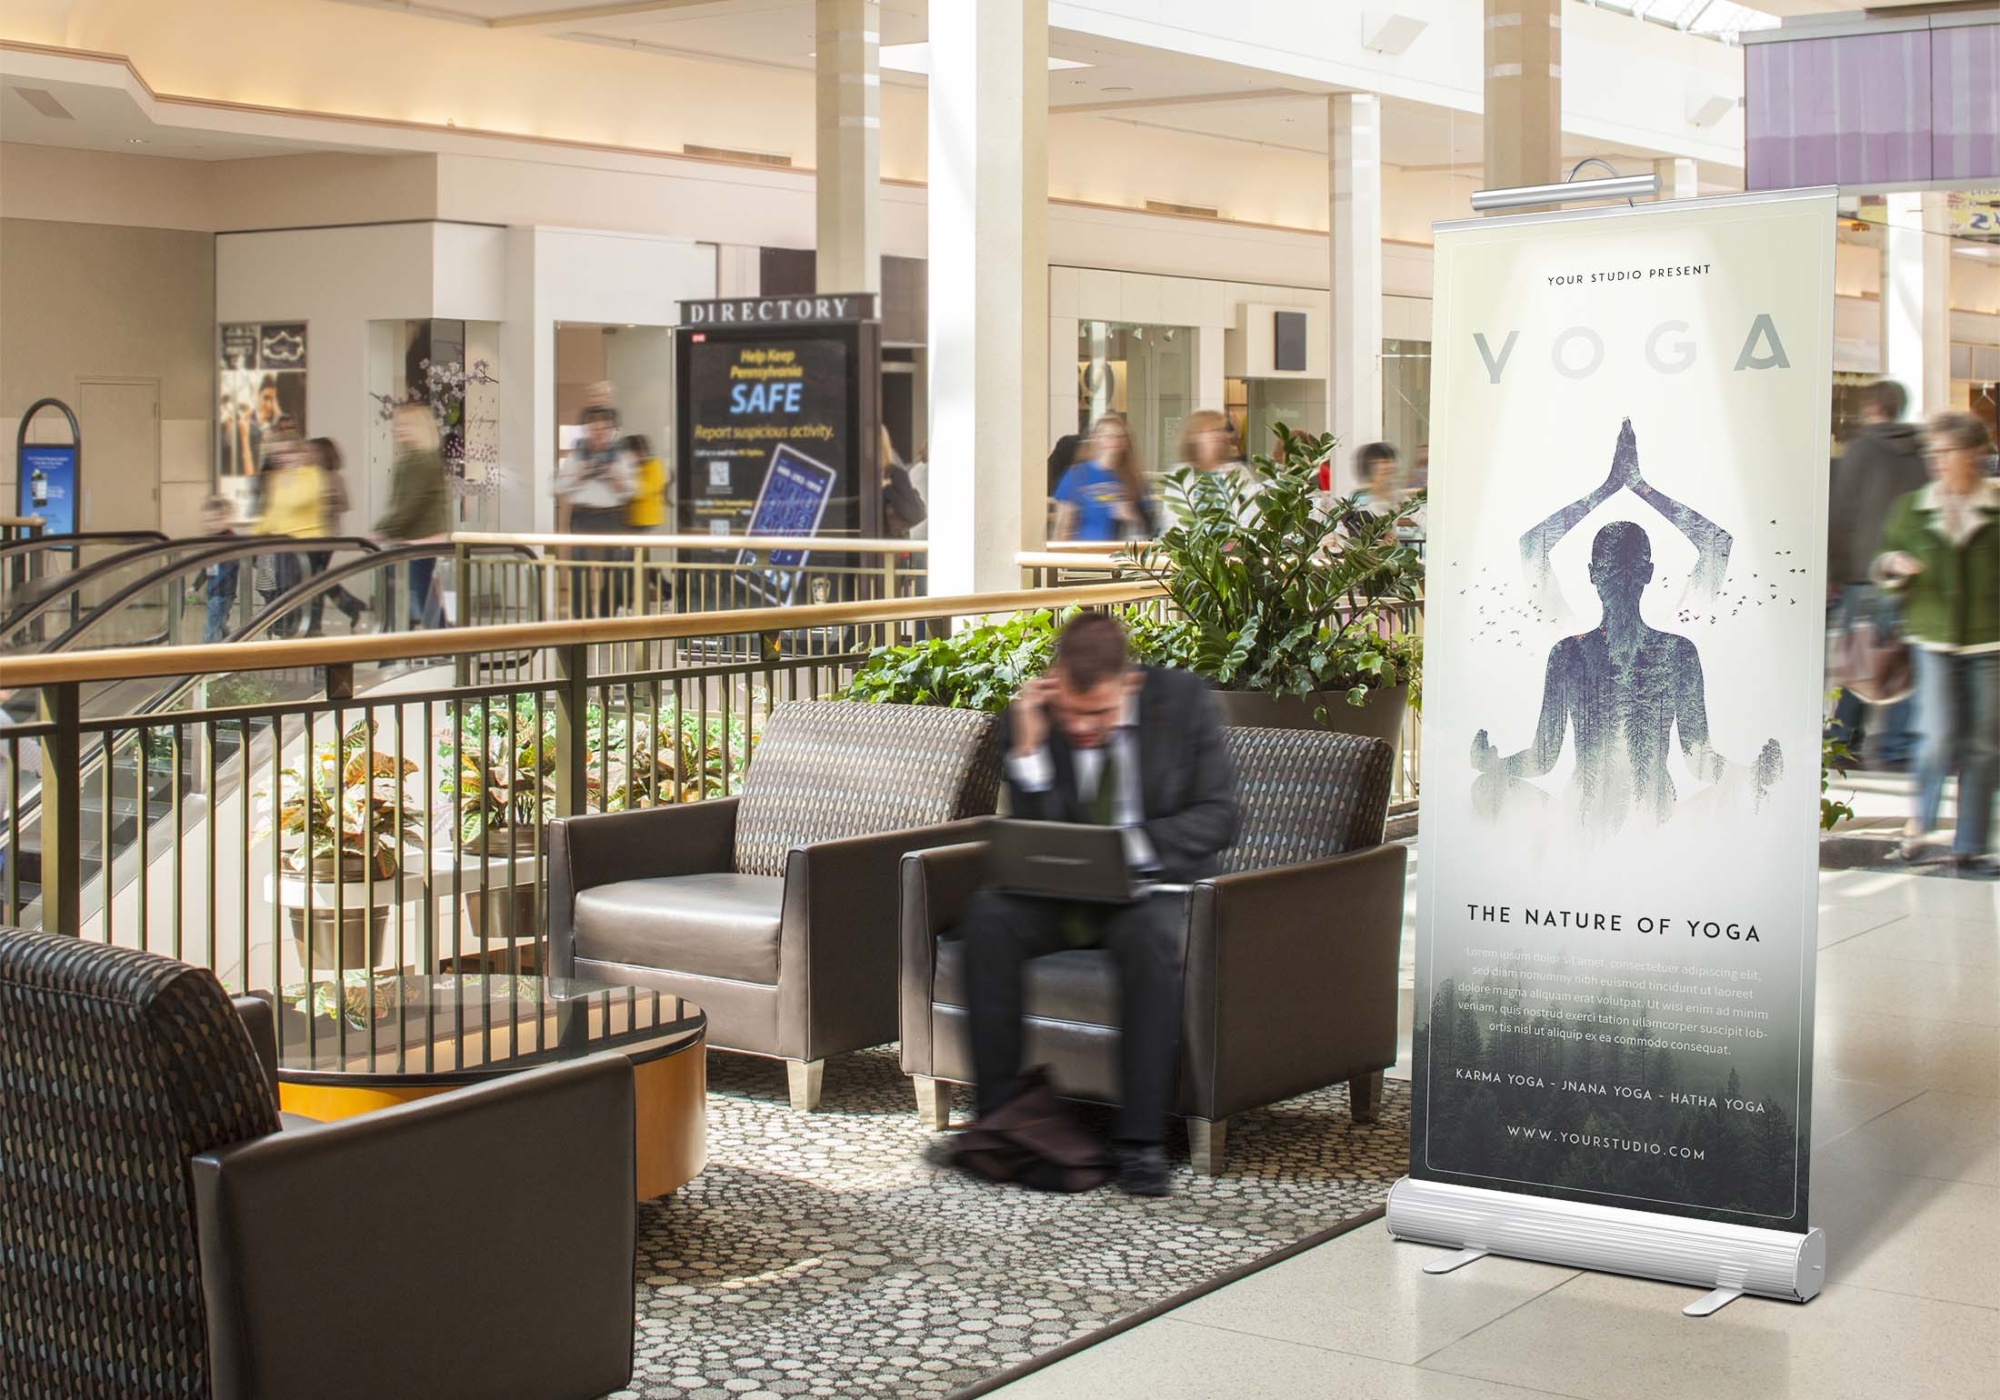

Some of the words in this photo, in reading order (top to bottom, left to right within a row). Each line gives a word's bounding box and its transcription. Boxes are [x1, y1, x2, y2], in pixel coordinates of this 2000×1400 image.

[1548, 274, 1583, 286] YOUR
[1591, 270, 1642, 283] STUDIO
[1649, 264, 1711, 278] PRESENT
[689, 298, 848, 323] DIRECTORY
[1472, 313, 1791, 384] YOGA
[729, 382, 803, 414] SAFE
[694, 424, 732, 441] Report
[1467, 904, 1511, 924] THE
[1525, 908, 1622, 932] NATURE
[1637, 917, 1671, 935] OF
[1687, 920, 1760, 942] YOGA
[1466, 947, 1498, 959] Lorem
[1500, 950, 1531, 963] ipsum
[1682, 964, 1738, 981] adipiscing
[1740, 968, 1762, 983] elit,
[1471, 965, 1490, 976] sed
[1492, 967, 1518, 978] diam
[1520, 971, 1572, 986] nonummy
[1575, 973, 1598, 986] nibh
[1600, 977, 1646, 990] euismod
[1648, 979, 1698, 995] tincidunt
[1700, 985, 1712, 996] ut
[1714, 986, 1753, 1000] laoreet
[1458, 982, 1491, 995] dolore
[1492, 986, 1527, 999] magna
[1529, 988, 1571, 1002] aliquam
[1573, 993, 1595, 1004] erat
[1597, 994, 1645, 1009] volutpat.
[1647, 999, 1660, 1010] Ut
[1662, 1001, 1684, 1012] wisi
[1685, 1003, 1713, 1015] enim
[1716, 1005, 1730, 1017] ad
[1732, 1007, 1769, 1020] minim
[1458, 1001, 1498, 1014] veniam,
[1500, 1006, 1521, 1018] quis
[1523, 1008, 1563, 1020] nostrud
[1565, 1011, 1596, 1023] exerci
[1598, 1014, 1630, 1027] tation
[1632, 1016, 1698, 1033] ullamcorper
[1700, 1024, 1743, 1038] suscipit
[1745, 1027, 1768, 1039] lob-
[1489, 1022, 1512, 1033] ortis
[1514, 1022, 1532, 1036] nisl
[1534, 1025, 1545, 1037] ut
[1547, 1027, 1583, 1042] aliquip
[1584, 1031, 1597, 1042] ex
[1599, 1033, 1612, 1043] ea
[1613, 1034, 1669, 1049] commodo
[1670, 1040, 1732, 1056] consequat.
[1456, 1068, 1502, 1084] KARMA
[1507, 1073, 1544, 1089] YOGA
[1561, 1080, 1607, 1096] JNANA
[1613, 1085, 1653, 1101] YOGA
[1670, 1092, 1718, 1108] HATHA
[1724, 1098, 1765, 1114] YOGA
[1506, 1124, 1705, 1161] WWW.YOURSTUDIO.COM
